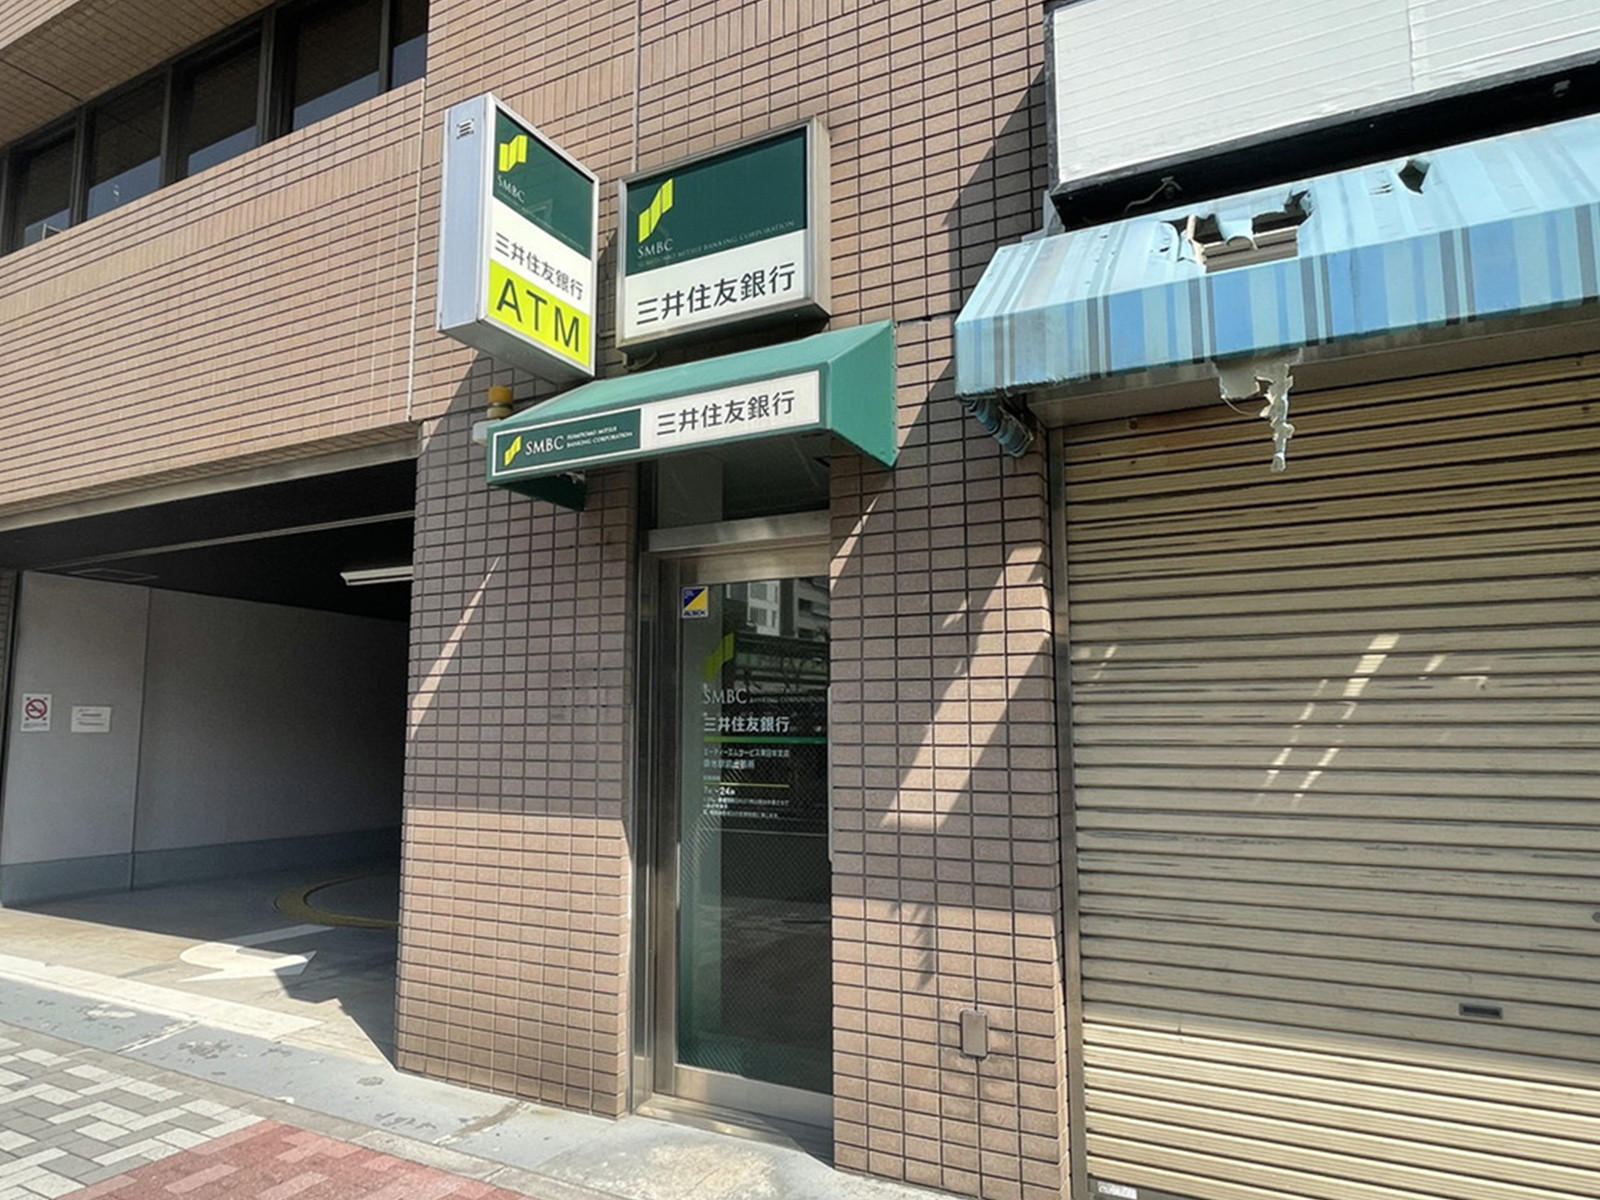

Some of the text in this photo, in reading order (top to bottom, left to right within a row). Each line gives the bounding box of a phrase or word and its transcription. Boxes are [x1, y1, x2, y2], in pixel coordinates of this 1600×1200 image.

[497, 175, 526, 203] SMBC
[637, 238, 674, 259] SMBC
[494, 231, 584, 301] 三井住友銀行
[636, 262, 796, 326] 三井住友銀行
[496, 277, 581, 353] ATM
[656, 390, 796, 436] 三井住友銀行
[525, 435, 565, 456] SMBC
[703, 688, 748, 704] SMBC
[703, 715, 790, 733] 三井住友銀行
